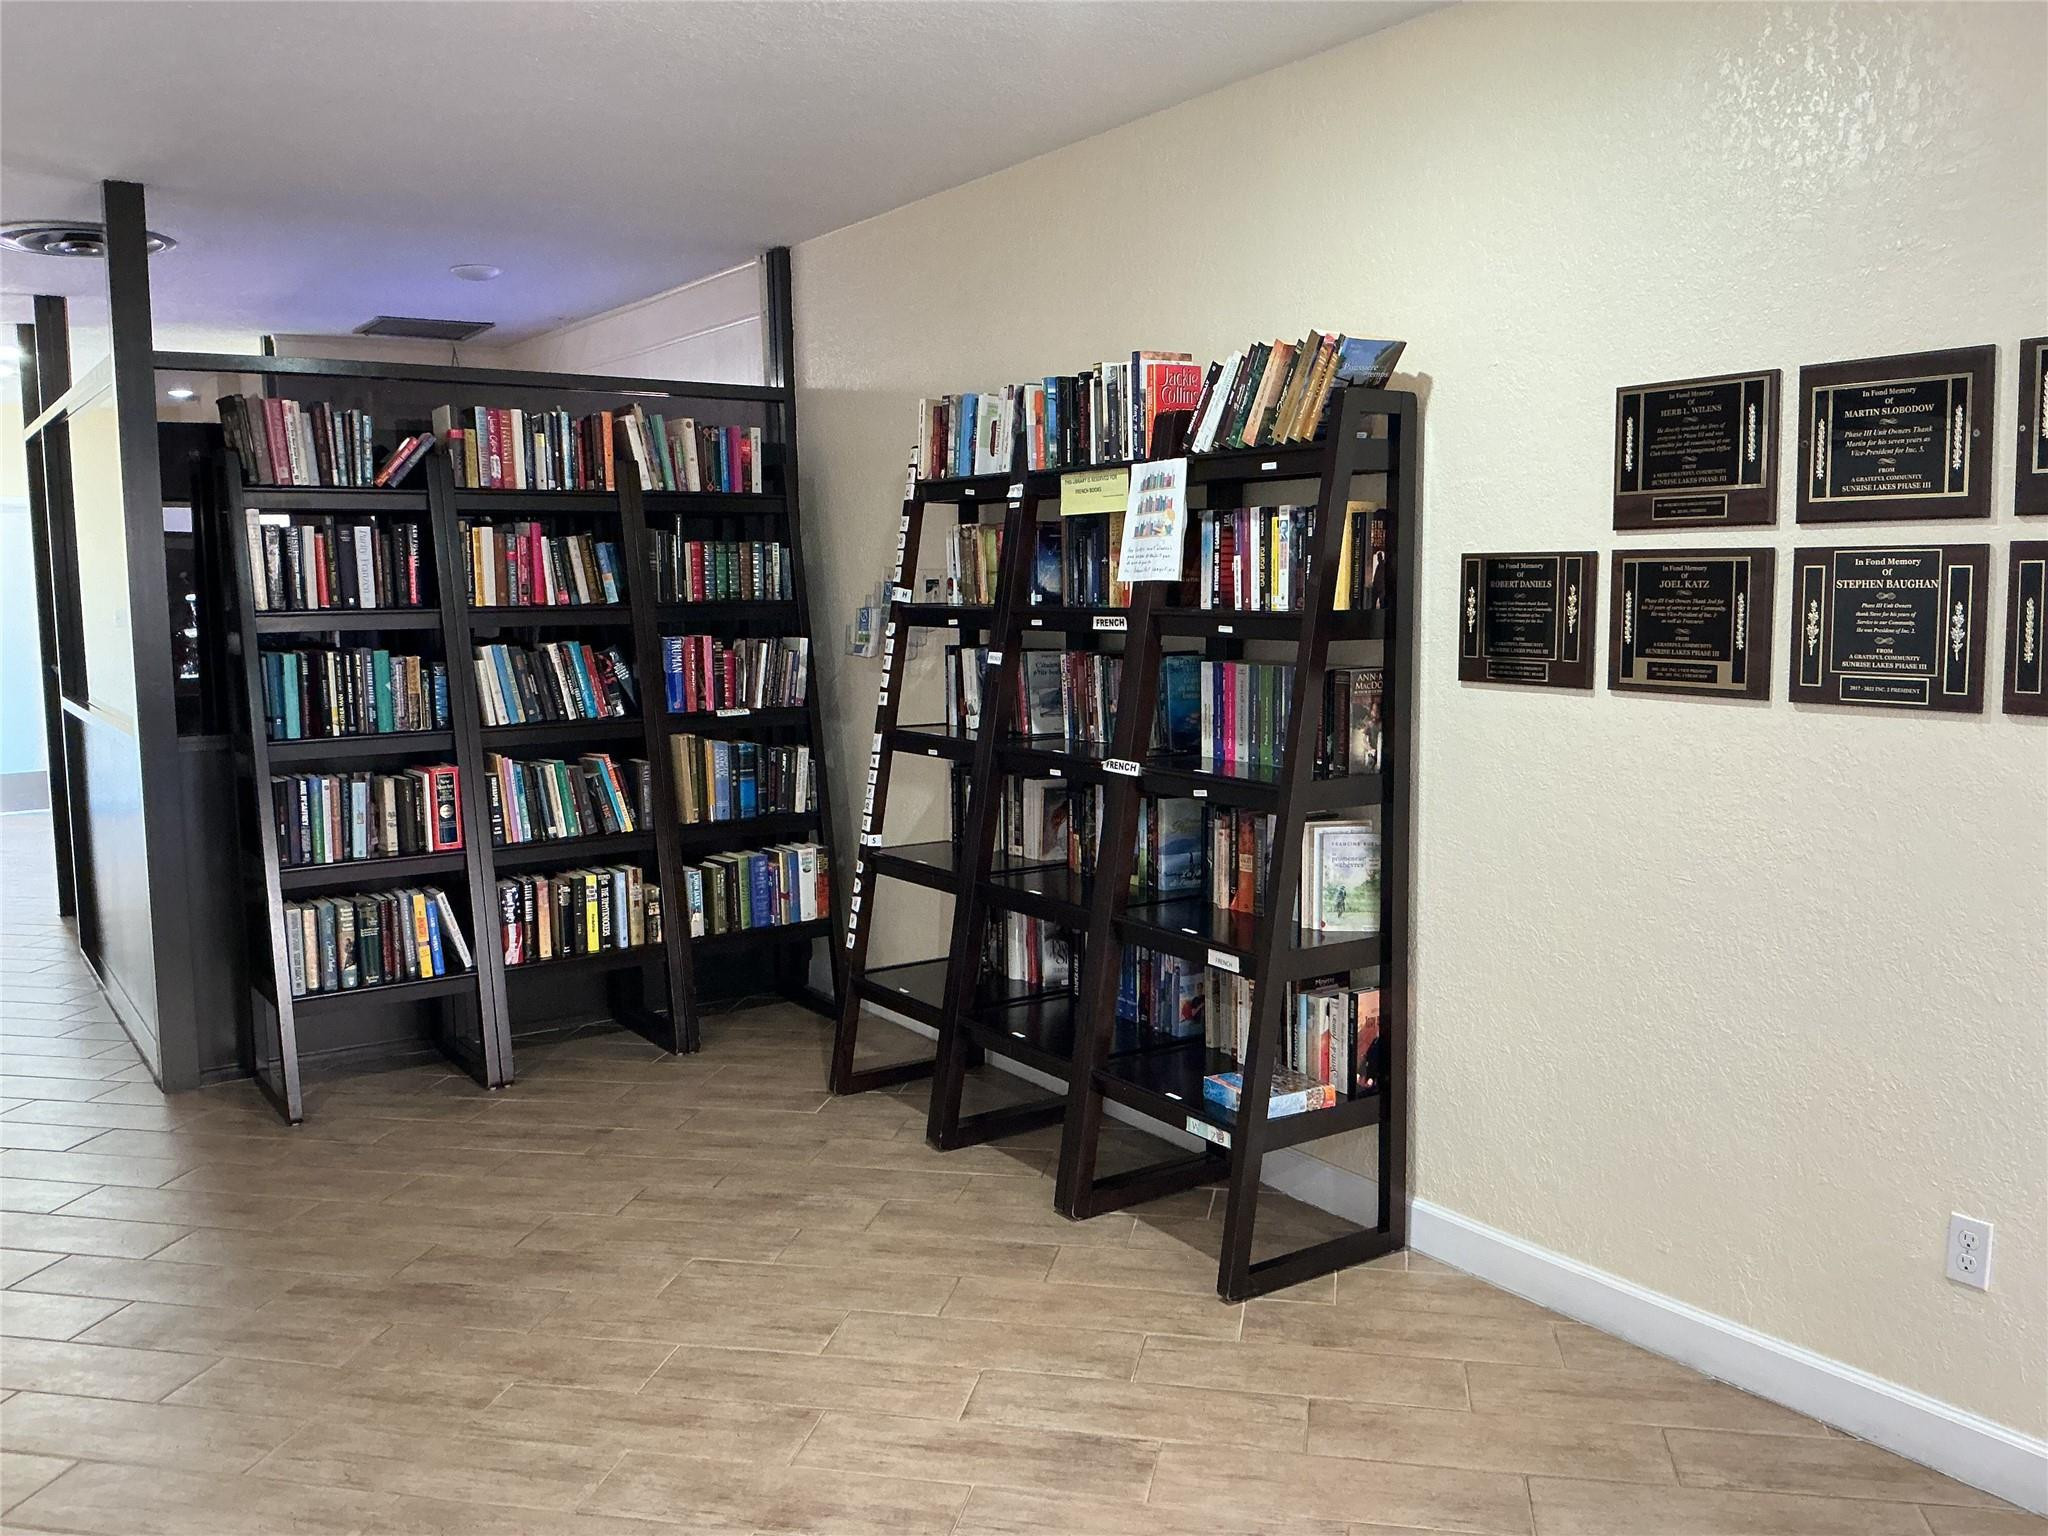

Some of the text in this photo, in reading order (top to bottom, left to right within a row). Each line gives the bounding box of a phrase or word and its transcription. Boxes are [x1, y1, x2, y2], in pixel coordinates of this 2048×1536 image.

[1162, 366, 1197, 388] Jackie
[1161, 386, 1200, 405] Collins
[1871, 388, 1888, 396] Fond
[1889, 387, 1916, 396] Memory
[1187, 380, 1210, 436] MICHAEL CONNELLY
[1660, 408, 1682, 417] HERB
[1692, 404, 1722, 414] WILENS
[1844, 403, 1935, 418] MARTIN SLOBODOW
[1842, 484, 1872, 492] SUNRISE
[1887, 558, 1921, 567] Memory
[1520, 580, 1552, 588] DANIELS
[1659, 580, 1710, 588] JOEL KATZ
[1836, 580, 1939, 589] STEPHEN BAUGHAN
[1096, 618, 1124, 627] FRENCH
[671, 638, 684, 673] TRUMAN
